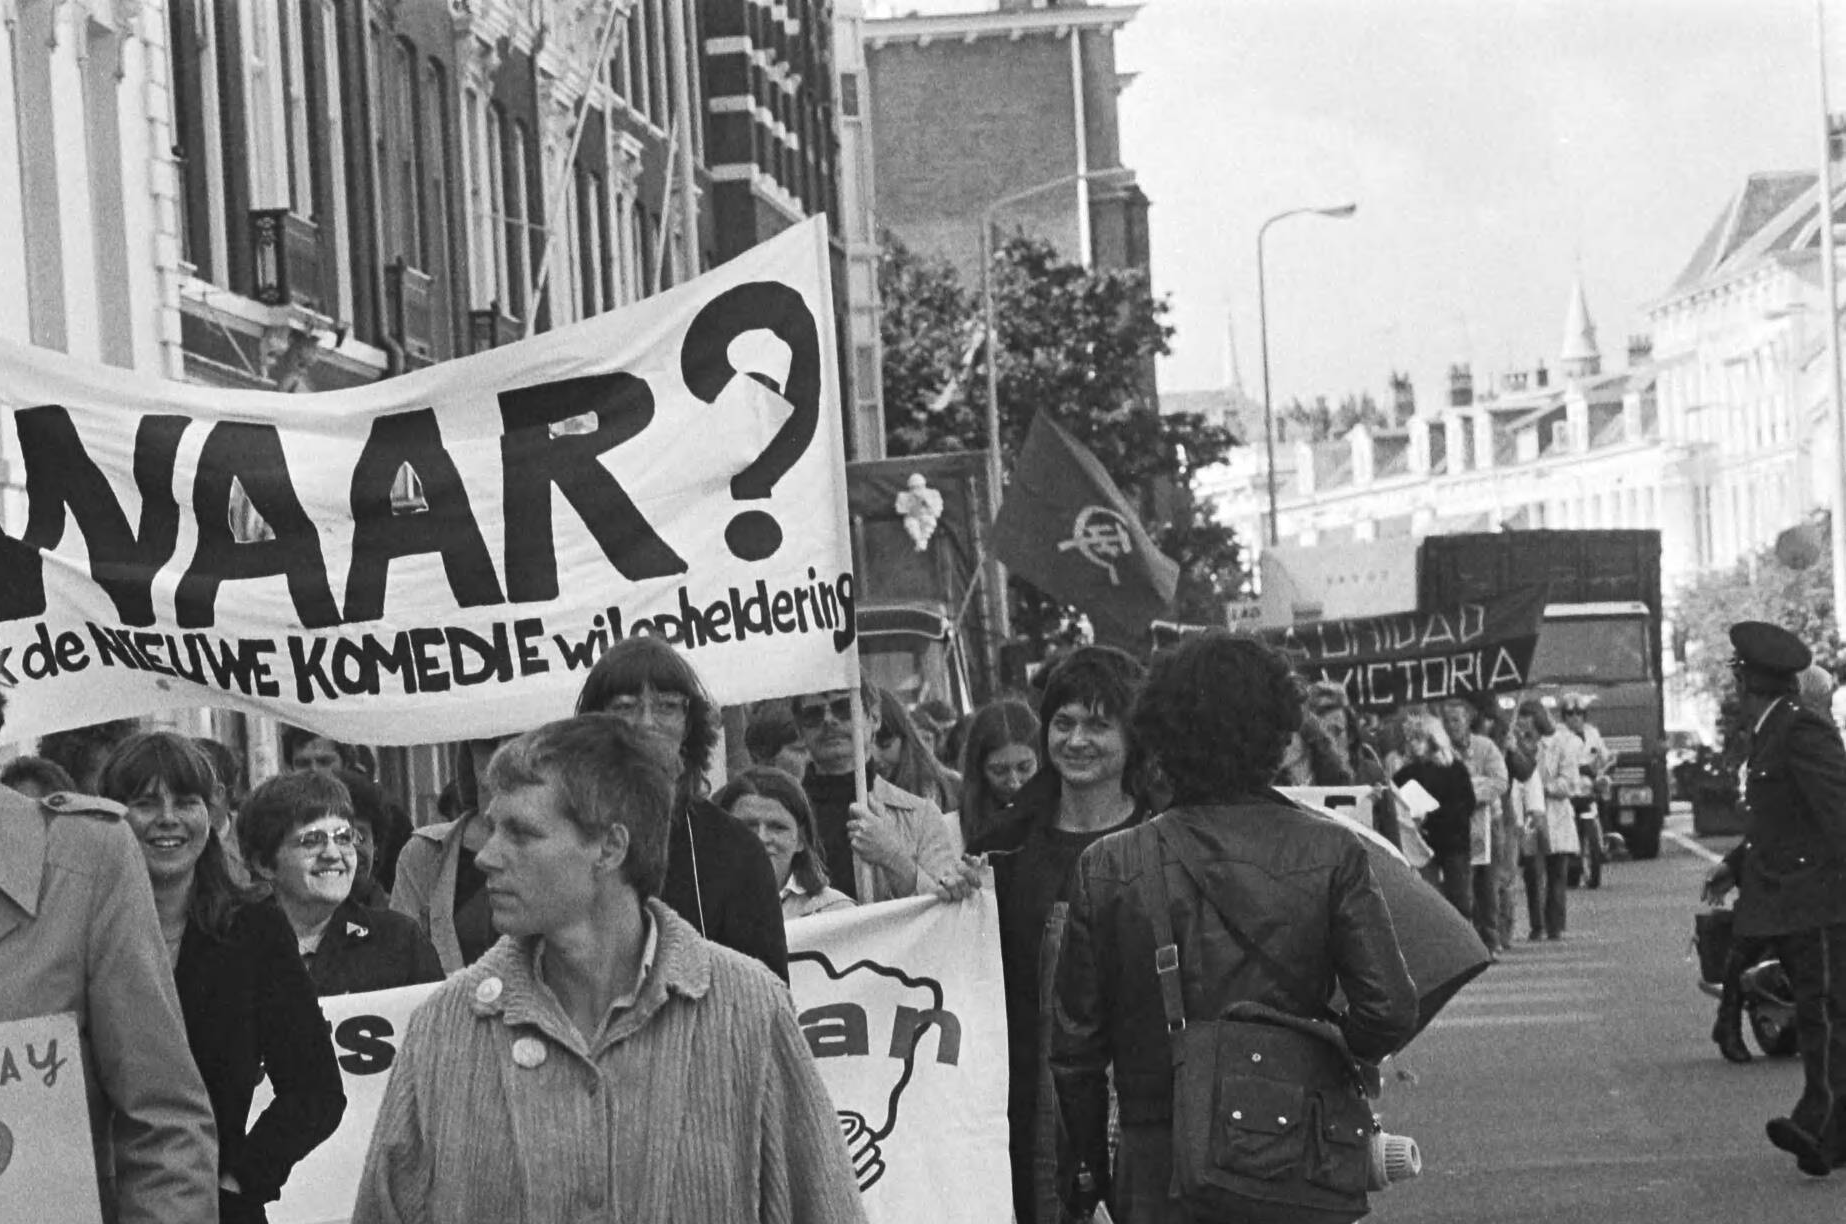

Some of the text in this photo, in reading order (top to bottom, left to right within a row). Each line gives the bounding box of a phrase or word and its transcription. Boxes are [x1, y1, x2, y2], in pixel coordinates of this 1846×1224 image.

[22, 622, 90, 680] de
[86, 621, 280, 697] NIEUWE
[288, 617, 550, 703] KOMEDIE
[553, 606, 622, 670] wil
